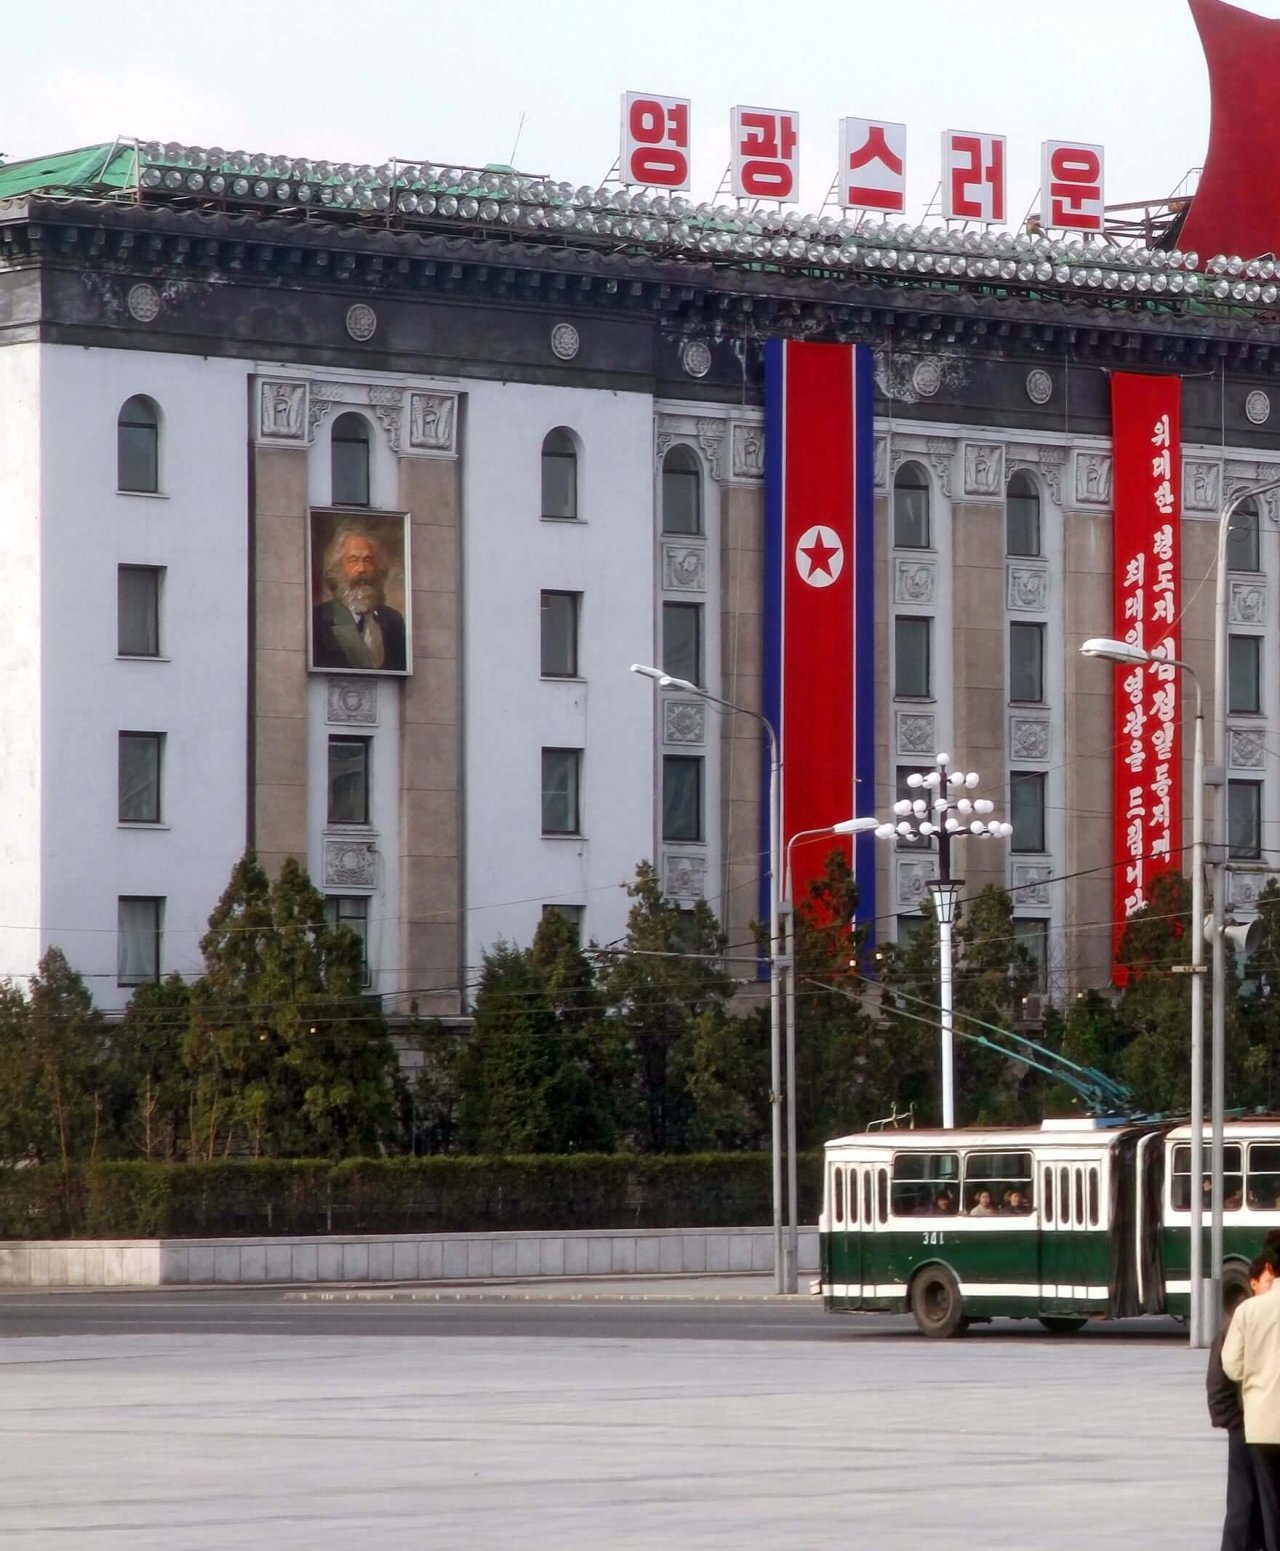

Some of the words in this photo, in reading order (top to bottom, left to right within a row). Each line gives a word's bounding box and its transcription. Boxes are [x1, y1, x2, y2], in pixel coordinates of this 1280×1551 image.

[629, 99, 1101, 228] 영광스러운
[1151, 414, 1174, 513] 위대한
[1123, 552, 1145, 650] 최대의
[1152, 524, 1175, 624] 령도자
[1123, 667, 1147, 772] 영광을
[1148, 637, 1176, 863] 김정일동지께
[1124, 786, 1149, 917] 드립니다
